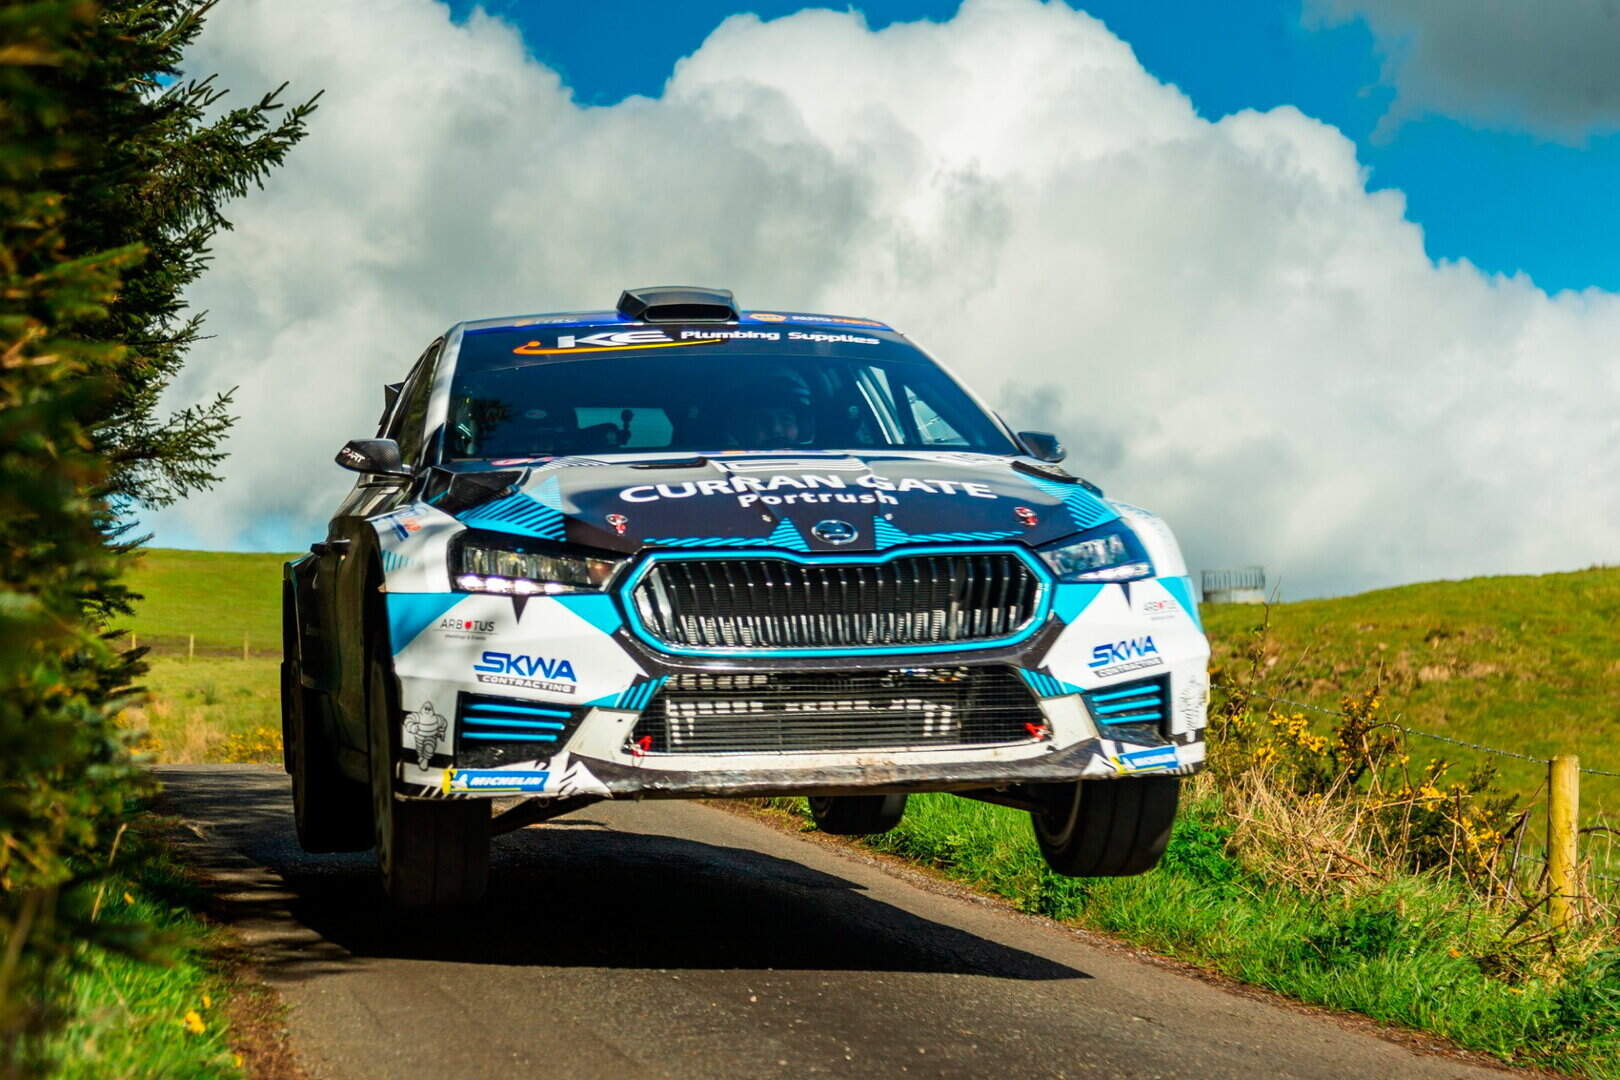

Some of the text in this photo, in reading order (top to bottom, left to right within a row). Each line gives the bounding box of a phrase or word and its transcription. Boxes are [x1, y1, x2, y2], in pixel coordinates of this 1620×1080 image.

[557, 330, 880, 348] KE Plumbing Supplies
[619, 474, 999, 503] CURRAN GATE
[737, 491, 899, 509] Portrush
[1088, 635, 1159, 668] SKWA
[473, 651, 577, 682] SKWA
[482, 675, 572, 694] CONTRACTING
[470, 776, 544, 787] MICHELIN
